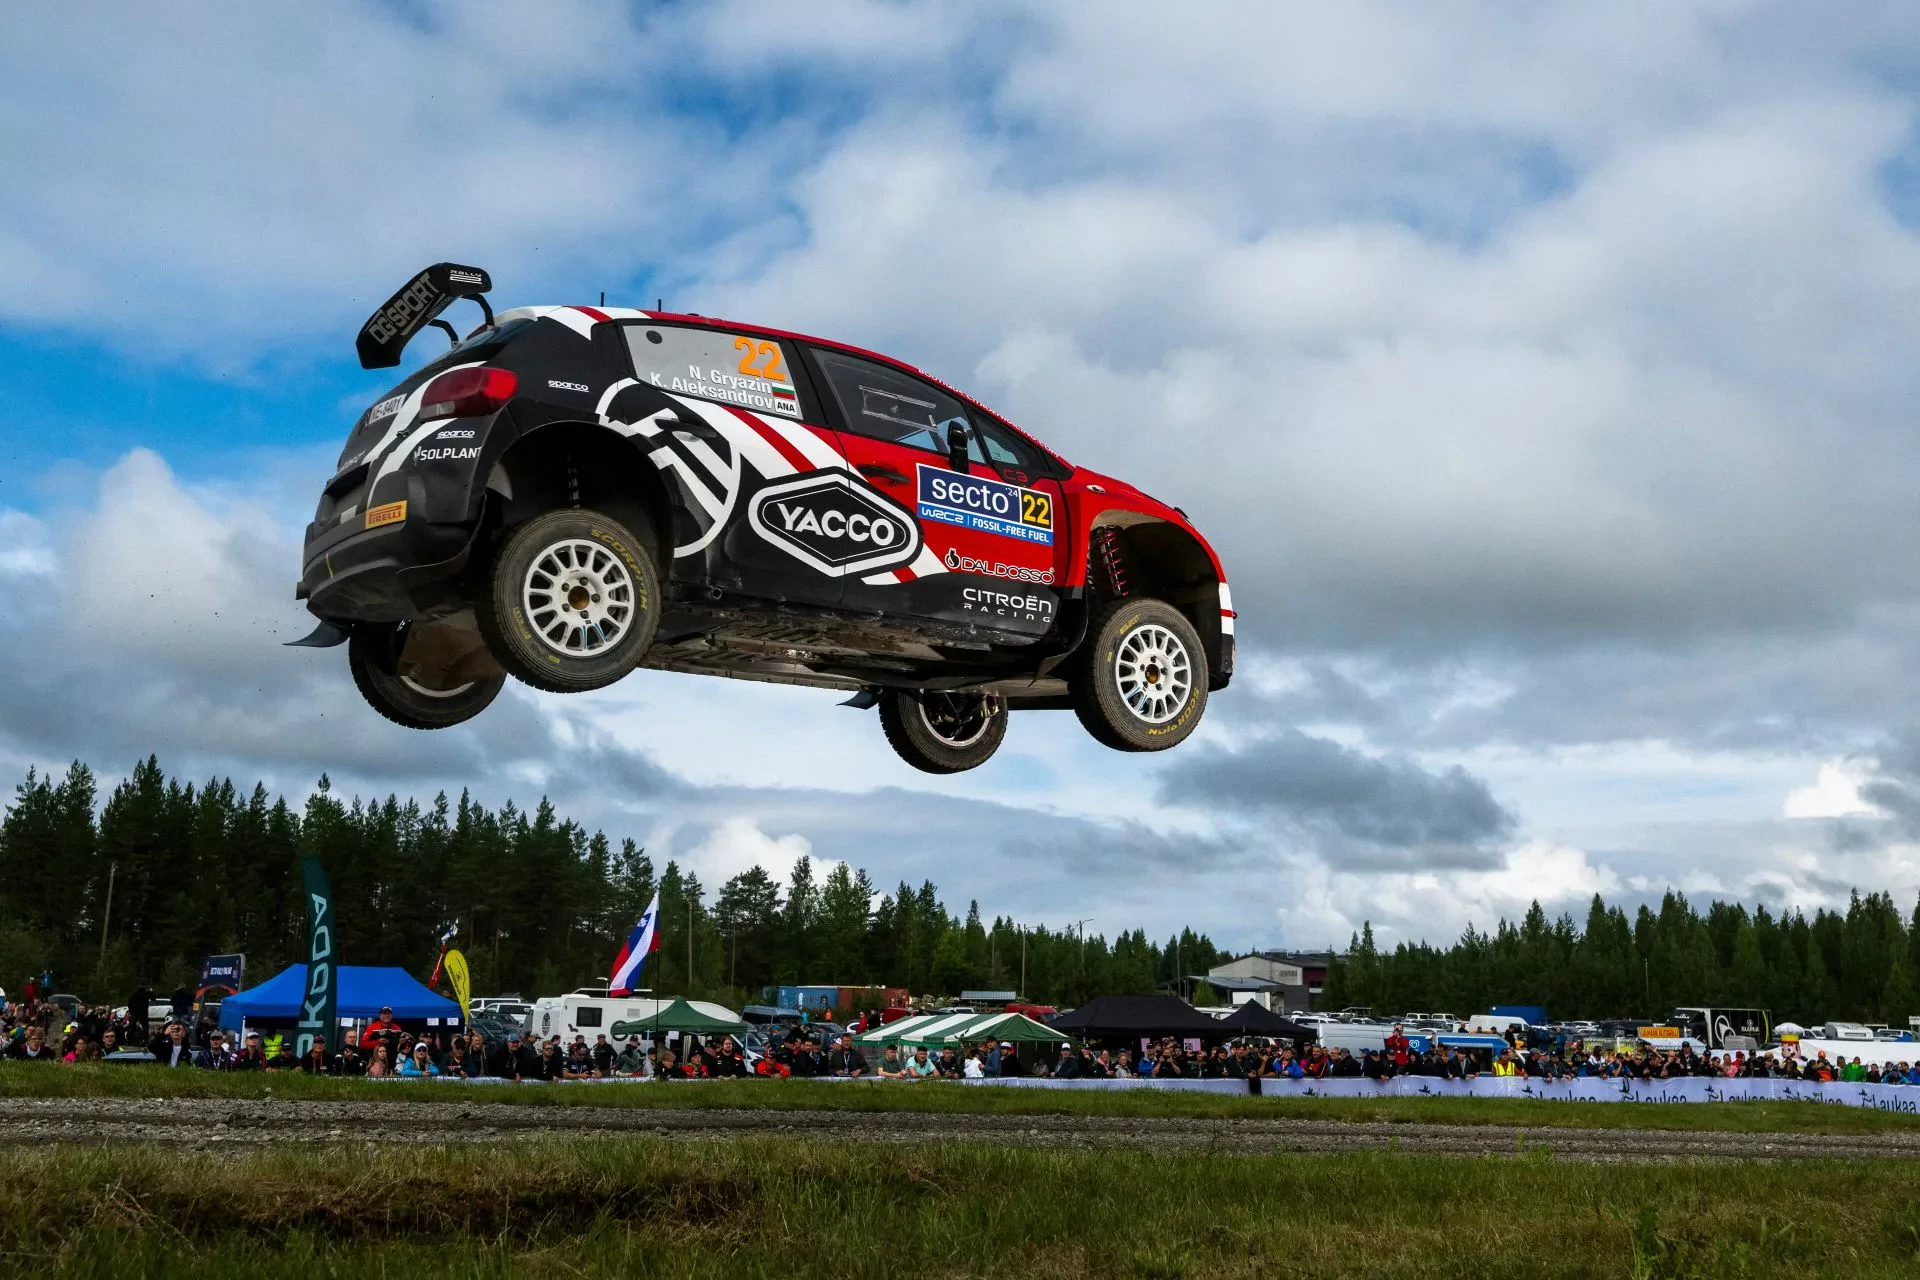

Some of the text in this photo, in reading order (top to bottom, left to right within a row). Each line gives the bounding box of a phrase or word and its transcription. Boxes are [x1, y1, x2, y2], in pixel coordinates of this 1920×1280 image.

[735, 336, 785, 382] 22
[548, 380, 589, 392] sparco
[650, 372, 773, 409] K. Aleksandrov
[688, 364, 772, 394] N. Gryazin
[777, 400, 796, 412] ANA
[436, 430, 476, 439] sparco
[1003, 468, 1028, 483] C3
[932, 478, 1009, 514] secto
[1023, 494, 1050, 526] 22
[368, 505, 402, 524] PIRELLI
[777, 503, 894, 546] YACCO
[921, 507, 1050, 543] WRC2 FOSSIL-FREE FUEL
